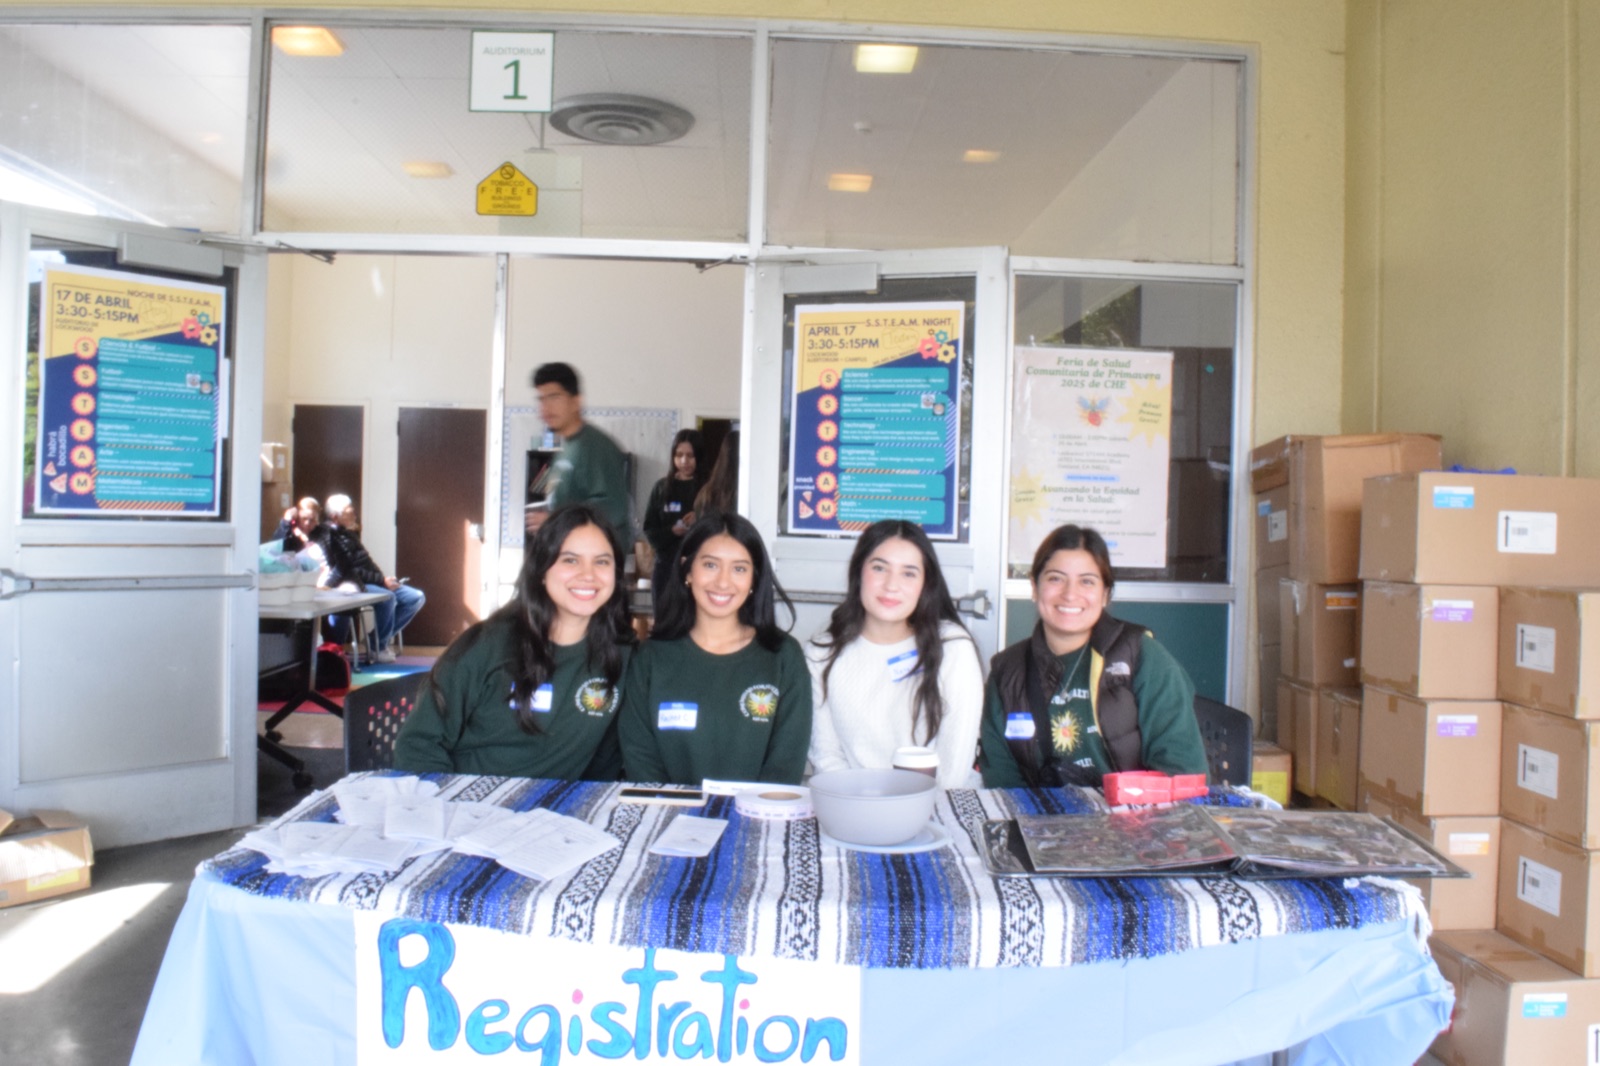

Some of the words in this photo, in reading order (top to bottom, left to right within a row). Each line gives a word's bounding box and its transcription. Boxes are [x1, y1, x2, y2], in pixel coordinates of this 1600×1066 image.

[482, 47, 546, 56] AUDITORIUM
[503, 59, 528, 100] 1
[56, 290, 72, 300] 17
[74, 292, 92, 304] DE
[94, 294, 132, 309] ABRIL
[127, 290, 155, 300] NOCHE
[56, 304, 140, 324] 3:30-5:15PM
[866, 318, 918, 327] S.S.T.E.A.M.
[922, 318, 952, 326] NIGHT
[808, 326, 840, 336] APRIL
[844, 326, 856, 336] 17
[82, 343, 89, 352] S
[808, 338, 879, 350] 3:30-5:15PM
[1056, 356, 1084, 367] Feria
[1087, 358, 1099, 367] de
[1102, 359, 1131, 368] Salud
[82, 370, 89, 380] S
[1026, 366, 1090, 377] Comunitaria
[1092, 368, 1105, 378] de
[1108, 370, 1161, 380] Primavera
[826, 374, 832, 383] S
[1061, 379, 1085, 388] 2025
[1088, 380, 1100, 388] de
[1104, 380, 1127, 389] CHE
[82, 400, 87, 408] T
[80, 425, 85, 435] E
[825, 427, 830, 435] T
[58, 424, 68, 466] bocadillo
[78, 450, 87, 460] A
[824, 452, 829, 461] E
[77, 478, 88, 487] M
[823, 477, 829, 486] A
[1041, 485, 1090, 494] Avanzando
[1092, 486, 1101, 494] la
[1104, 486, 1140, 496] Equidad
[1087, 495, 1115, 504] Salud:
[822, 504, 831, 513] M
[378, 917, 848, 1066] Registration
